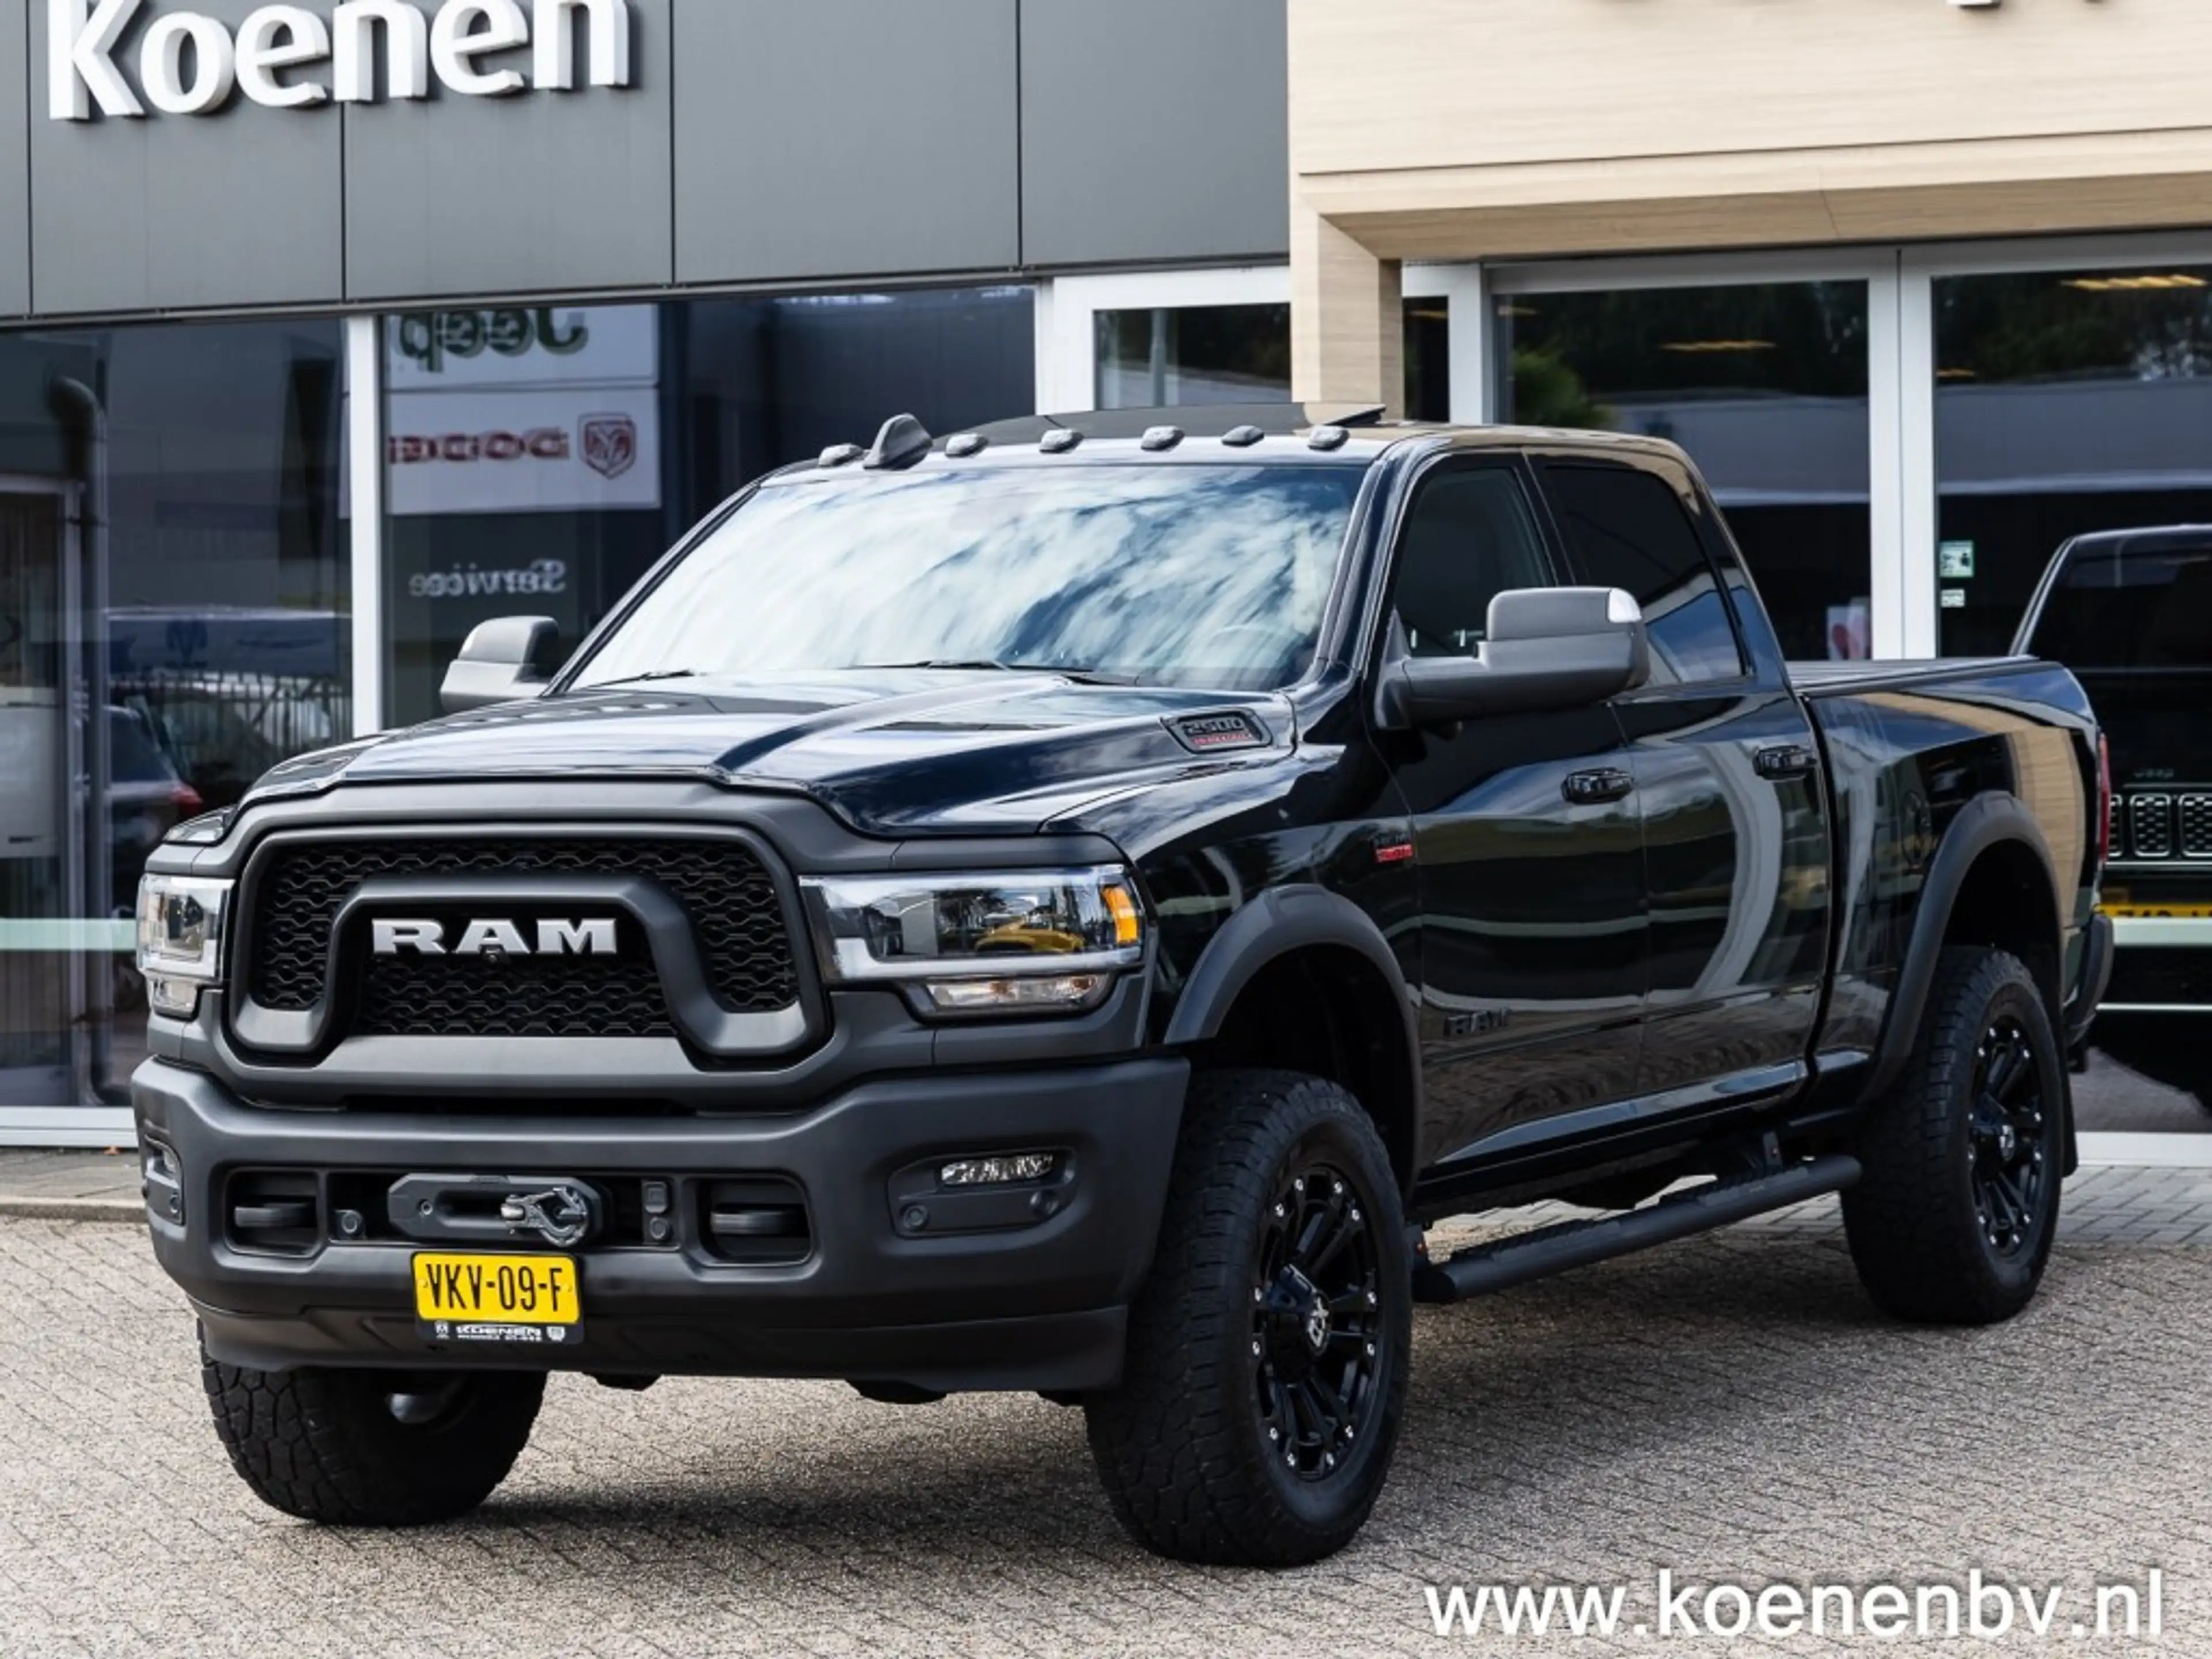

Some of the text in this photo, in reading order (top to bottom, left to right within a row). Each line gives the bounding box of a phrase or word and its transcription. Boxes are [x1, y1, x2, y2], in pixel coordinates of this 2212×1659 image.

[48, 0, 630, 121] Koenen
[371, 917, 618, 956] RAM
[426, 1264, 562, 1311] VKV-09-F
